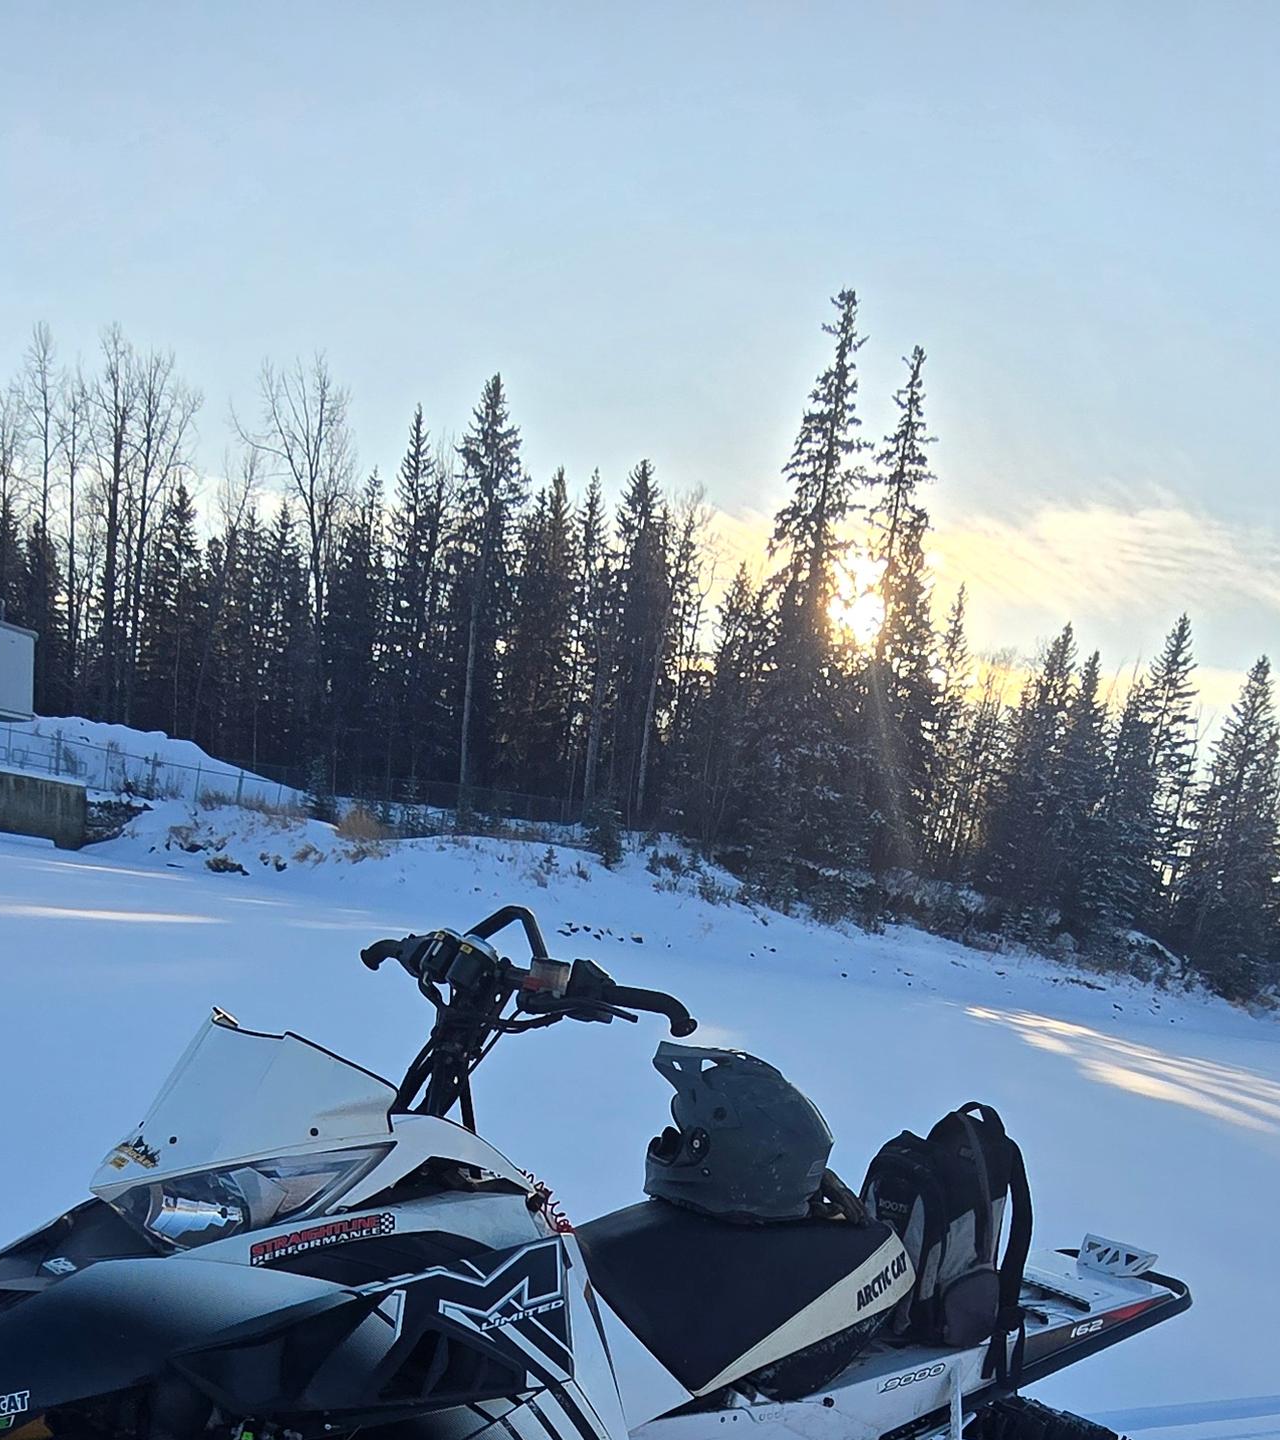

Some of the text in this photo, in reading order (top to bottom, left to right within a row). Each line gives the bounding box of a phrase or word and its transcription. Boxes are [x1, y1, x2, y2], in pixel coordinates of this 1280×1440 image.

[251, 1214, 381, 1257] STRAIGHTLINE
[252, 1226, 382, 1266] PERFORMANCE
[856, 1250, 908, 1312] ARCTIC CAT
[481, 1299, 565, 1331] LIMITED
[1070, 1319, 1104, 1339] 162
[879, 1362, 946, 1394] 9000
